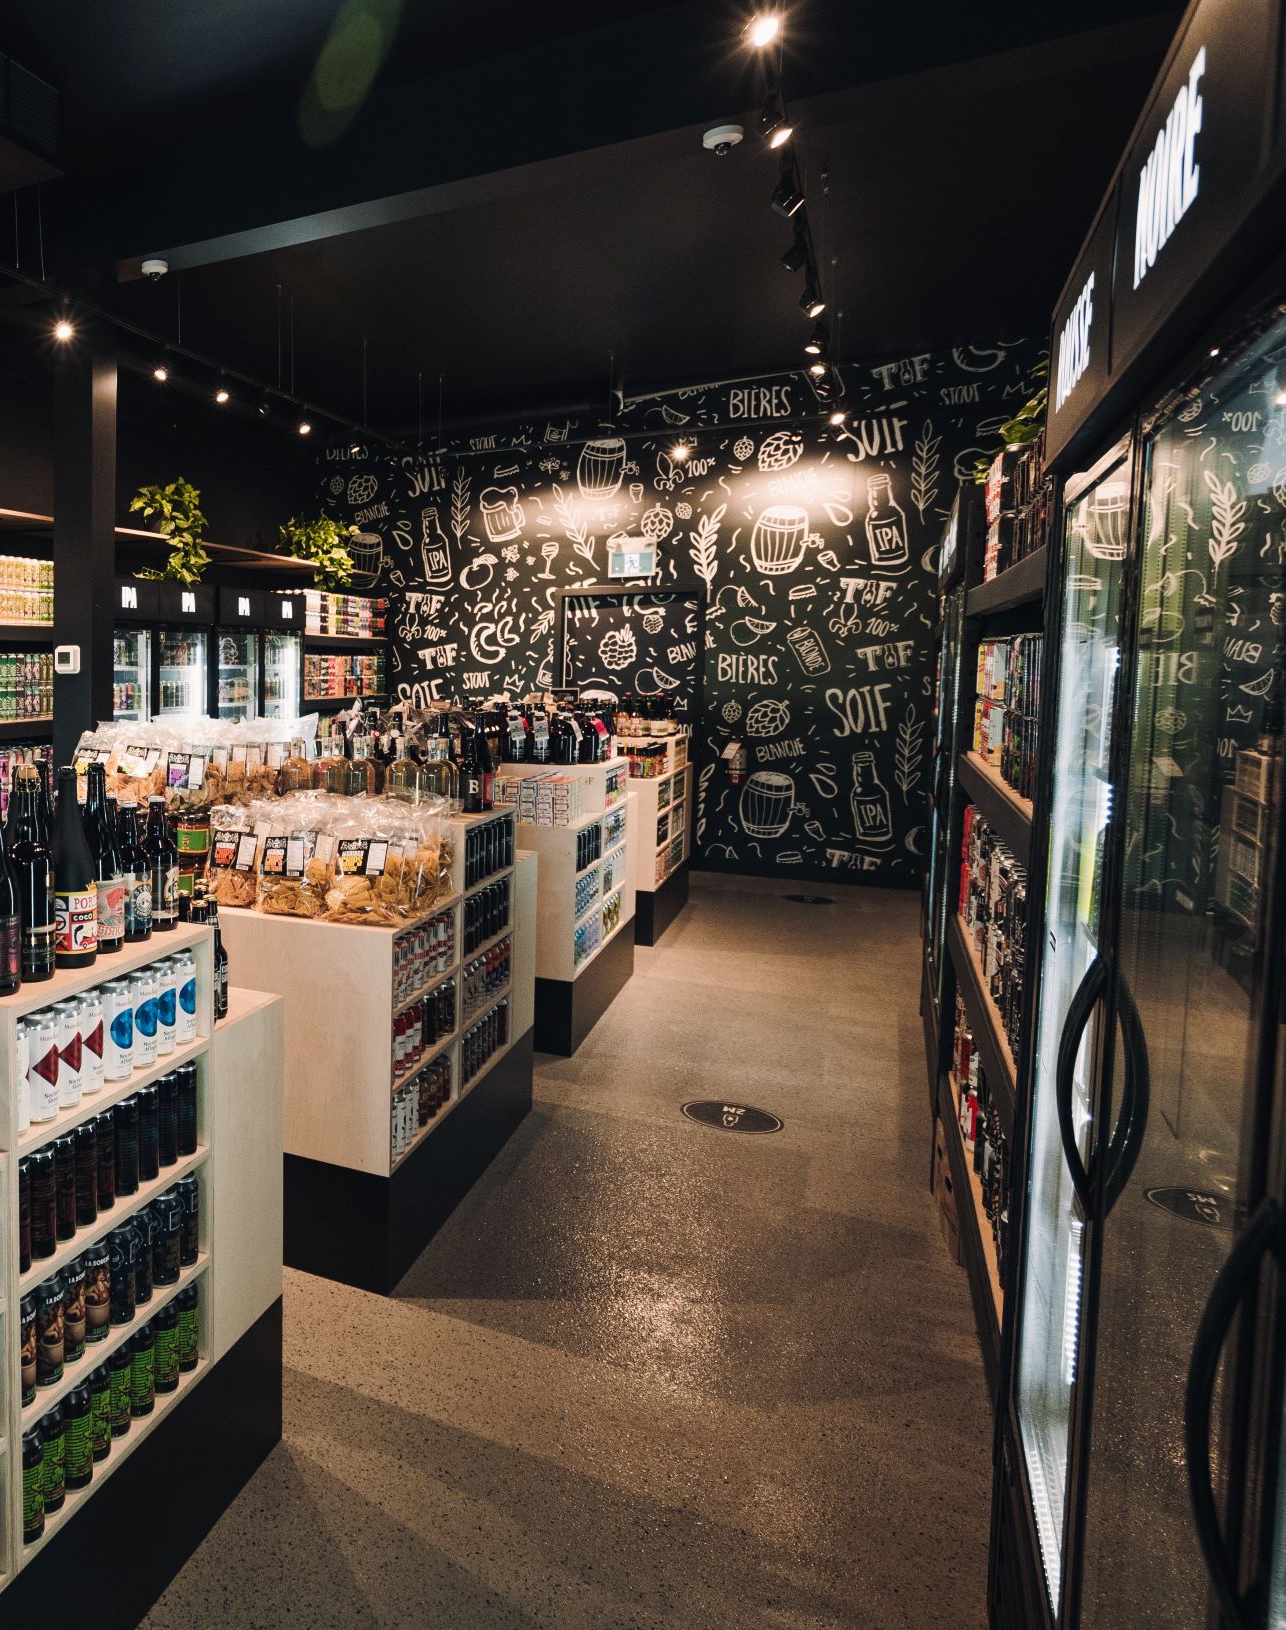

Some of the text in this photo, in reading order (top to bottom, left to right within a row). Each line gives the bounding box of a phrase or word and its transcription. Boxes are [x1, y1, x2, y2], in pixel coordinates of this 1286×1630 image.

[1134, 46, 1206, 290] NOIRE
[729, 386, 791, 418] BIÈRES
[940, 383, 982, 406] STOUT
[469, 435, 497, 451] STOUT
[354, 502, 391, 526] BLANCHE
[875, 526, 903, 551] IPA
[428, 552, 447, 571] IPA
[795, 638, 825, 672] BLONDE
[463, 671, 491, 689] STOUT
[717, 651, 779, 685] BIÈRES
[825, 683, 892, 737] SOIF
[756, 738, 807, 762] BLANCHE
[860, 803, 887, 827] IPA
[72, 912, 93, 921] COCO
